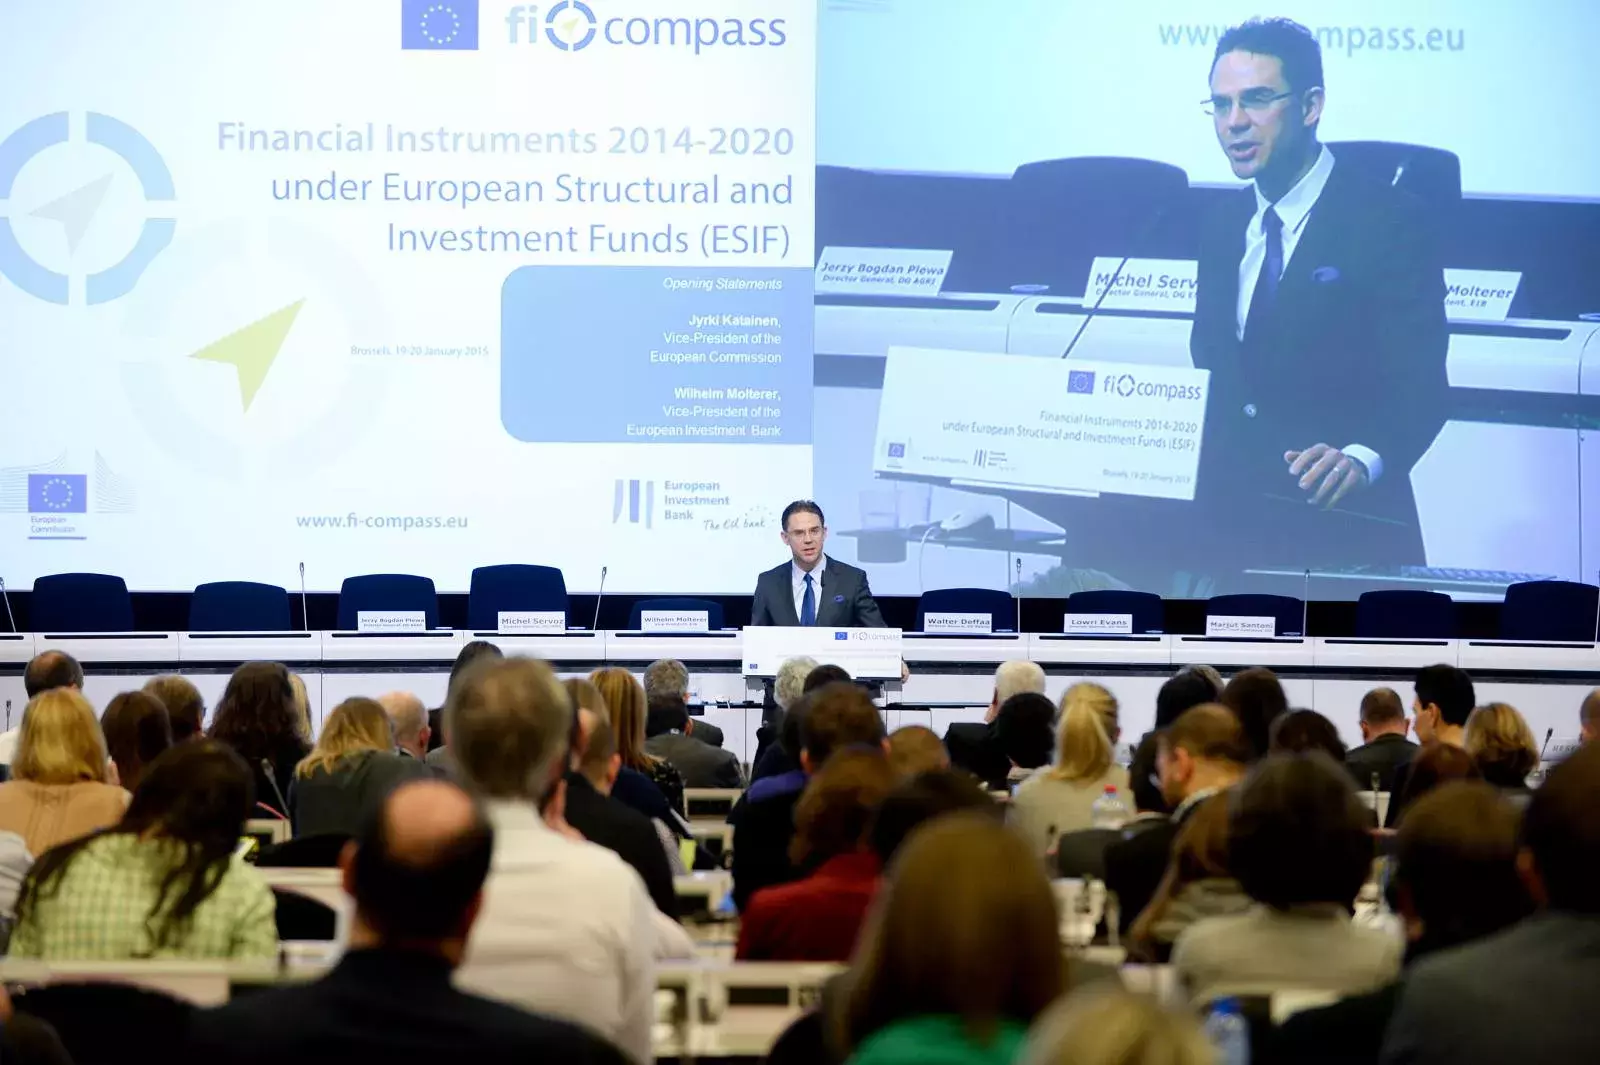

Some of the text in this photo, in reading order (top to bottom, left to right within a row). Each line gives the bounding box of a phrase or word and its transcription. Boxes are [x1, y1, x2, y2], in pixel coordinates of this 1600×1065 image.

[604, 17, 787, 55] compass
[1159, 22, 1465, 57] wwmpass.eu
[217, 121, 794, 155] Financial Instruments 2014-2020
[272, 170, 792, 209] under European Structural and
[388, 223, 790, 258] Investment Funds (ESIF)
[821, 262, 944, 275] Jerzy Bogdan Plewa
[662, 277, 782, 291] Opening Statements
[1095, 273, 1198, 289] Mchel Serv
[1447, 284, 1513, 299] Molterer
[688, 314, 782, 329] Jyrki Katainen,
[663, 331, 782, 344] Vice-President of the
[650, 350, 782, 364] European Commission
[674, 387, 782, 401] Wilhelm Molterer,
[1136, 381, 1202, 401] compass
[662, 404, 781, 417] Vice-President of the
[1039, 410, 1198, 434] Financial Instruments 2014-2020
[626, 424, 782, 439] European Investment Bank
[942, 421, 970, 432] under
[971, 421, 1015, 436] European
[1016, 425, 1063, 440] Structural
[1063, 429, 1081, 441] and
[1083, 431, 1136, 446] Investment
[1138, 434, 1167, 449] Funds
[664, 480, 720, 493] European
[664, 495, 730, 506] Investment
[296, 512, 468, 531] www.fi-compass.eu
[664, 510, 694, 520] Bank
